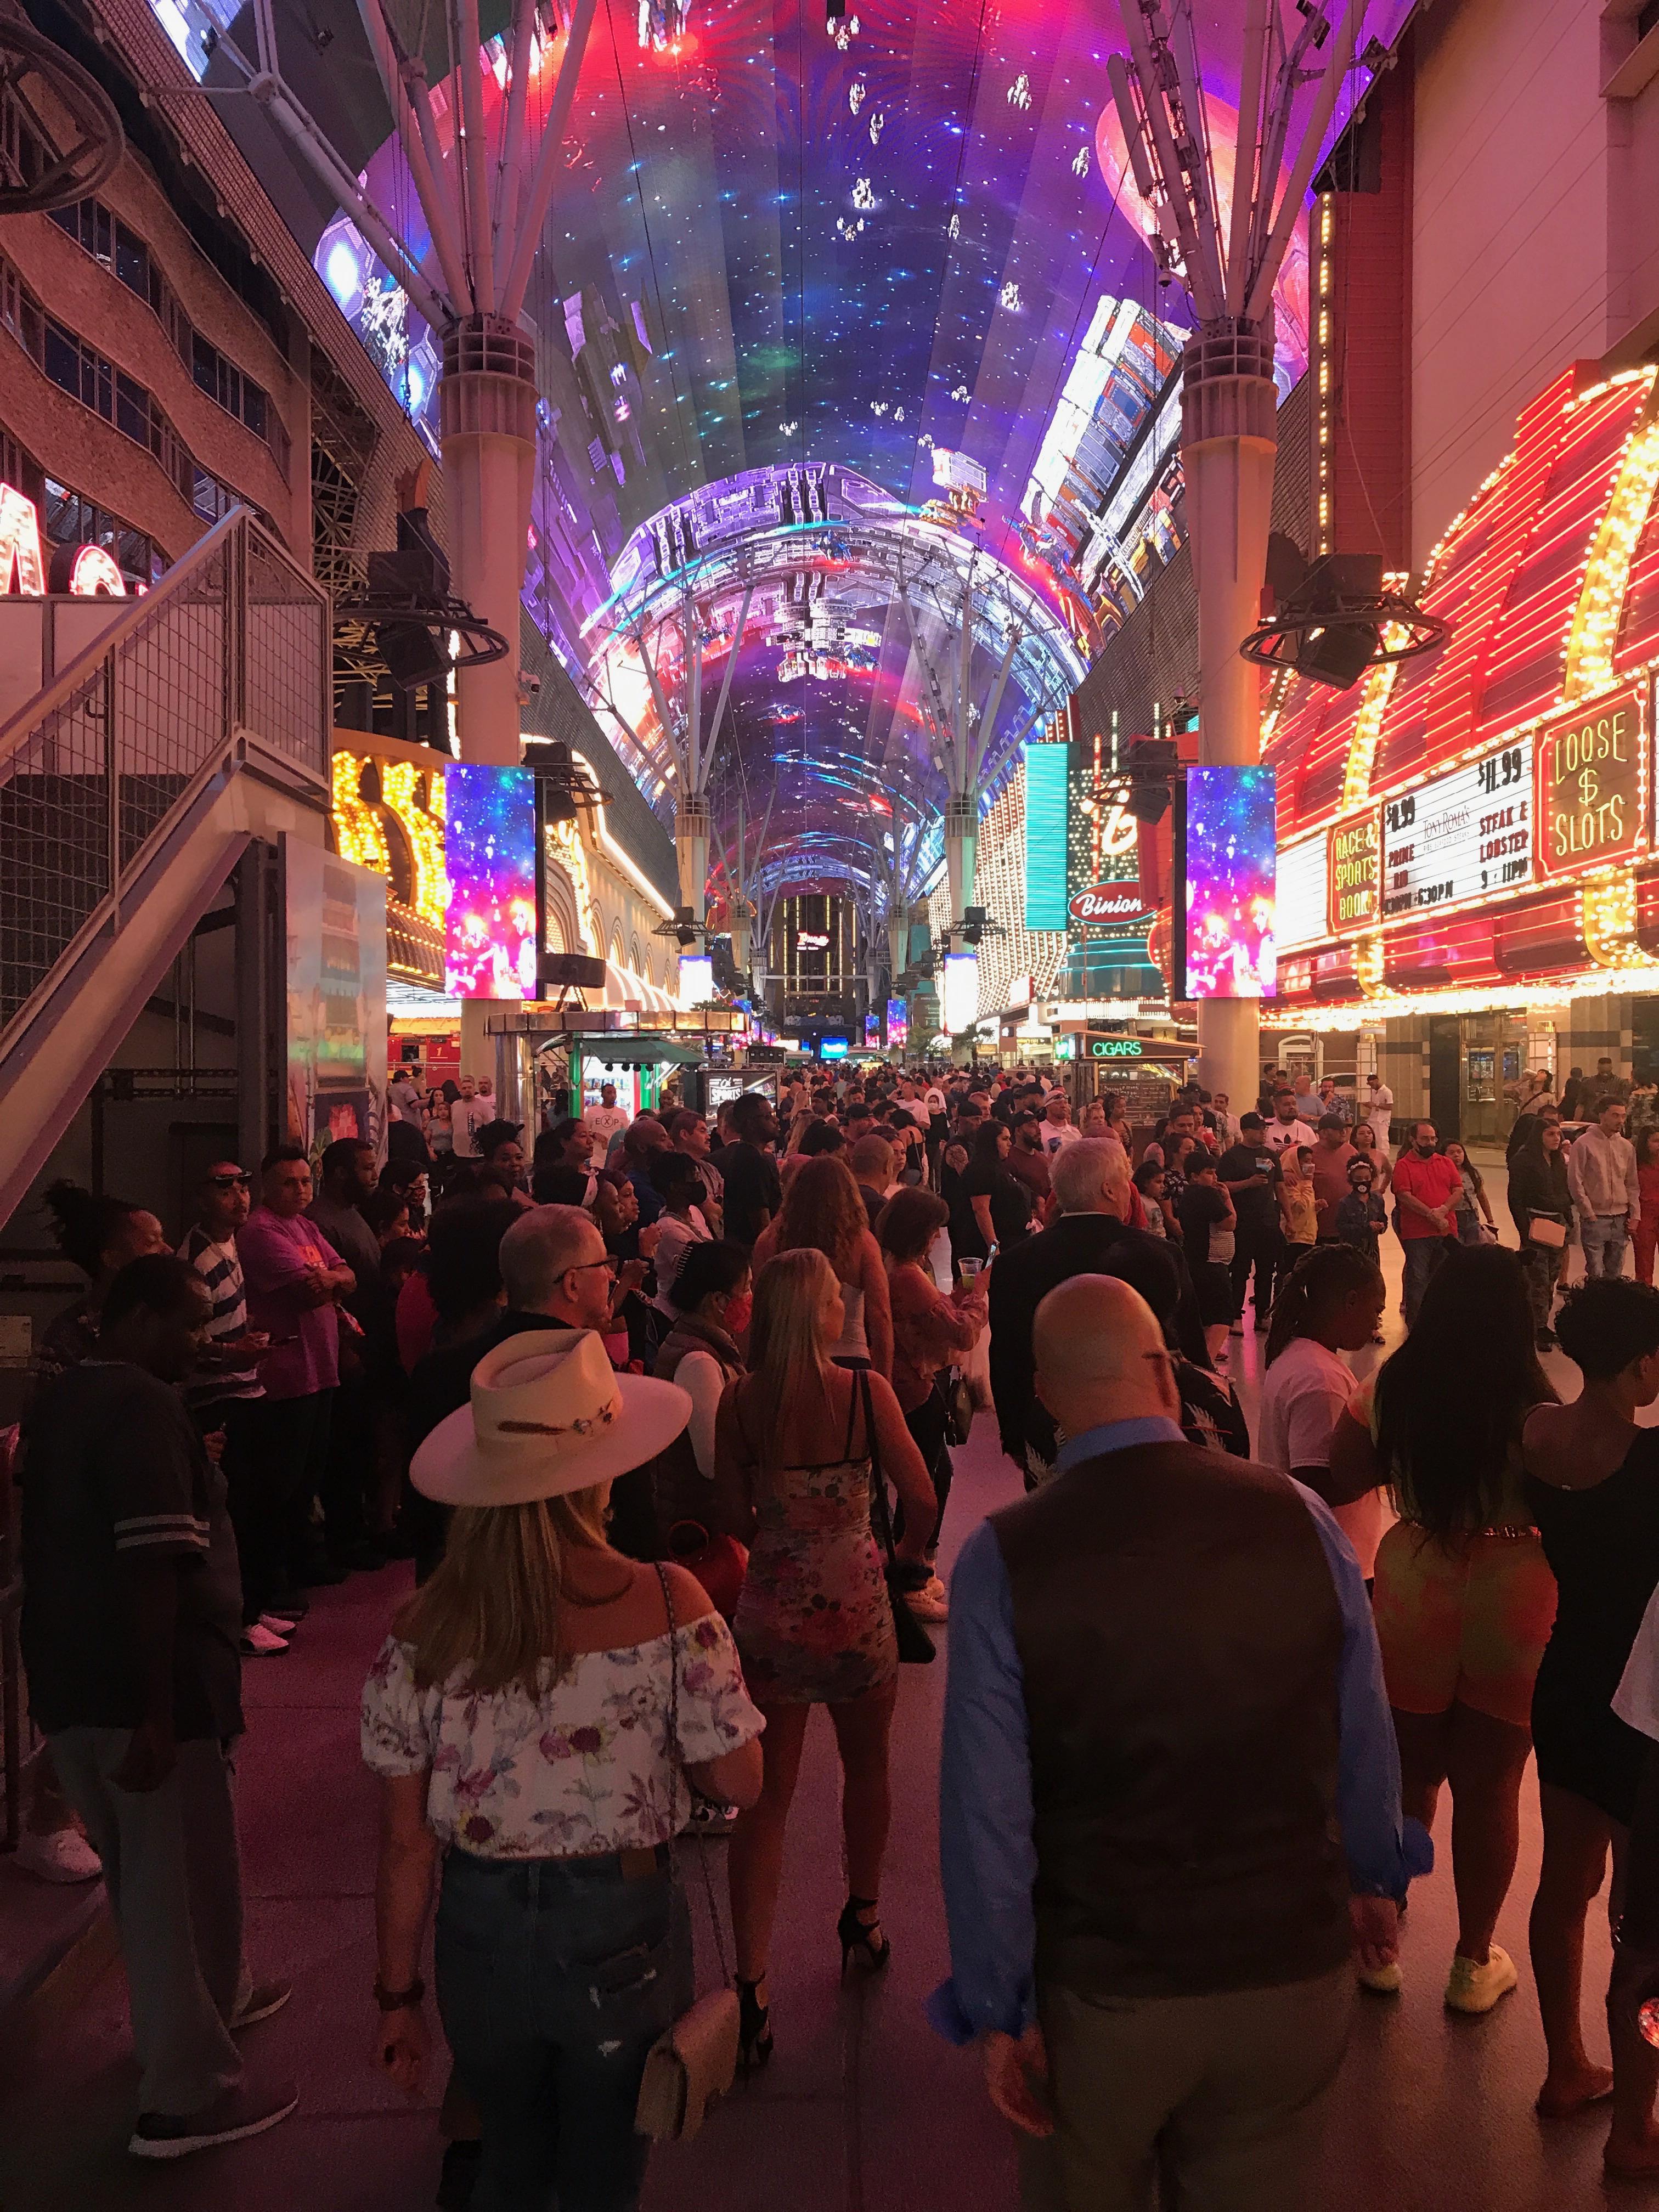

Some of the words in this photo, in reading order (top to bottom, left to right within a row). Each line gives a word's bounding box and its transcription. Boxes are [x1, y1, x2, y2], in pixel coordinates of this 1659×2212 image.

[1556, 712, 1628, 785] LOOSE
[1478, 748, 1522, 794] $11.99
[1578, 768, 1598, 806] $
[1423, 820, 1440, 839] TONY
[1442, 805, 1470, 834] ROMA'S
[1479, 806, 1514, 837] STEAK
[1555, 794, 1626, 856] SLOTS
[1335, 828, 1364, 861] RACE
[1388, 843, 1414, 868] PRIME
[1480, 828, 1529, 863] LOBSTER
[1335, 855, 1375, 891] SPORTS
[1340, 890, 1372, 921] BOOK
[1092, 1041, 1142, 1056] CIGARS
[712, 1088, 741, 1102] SPORTS
